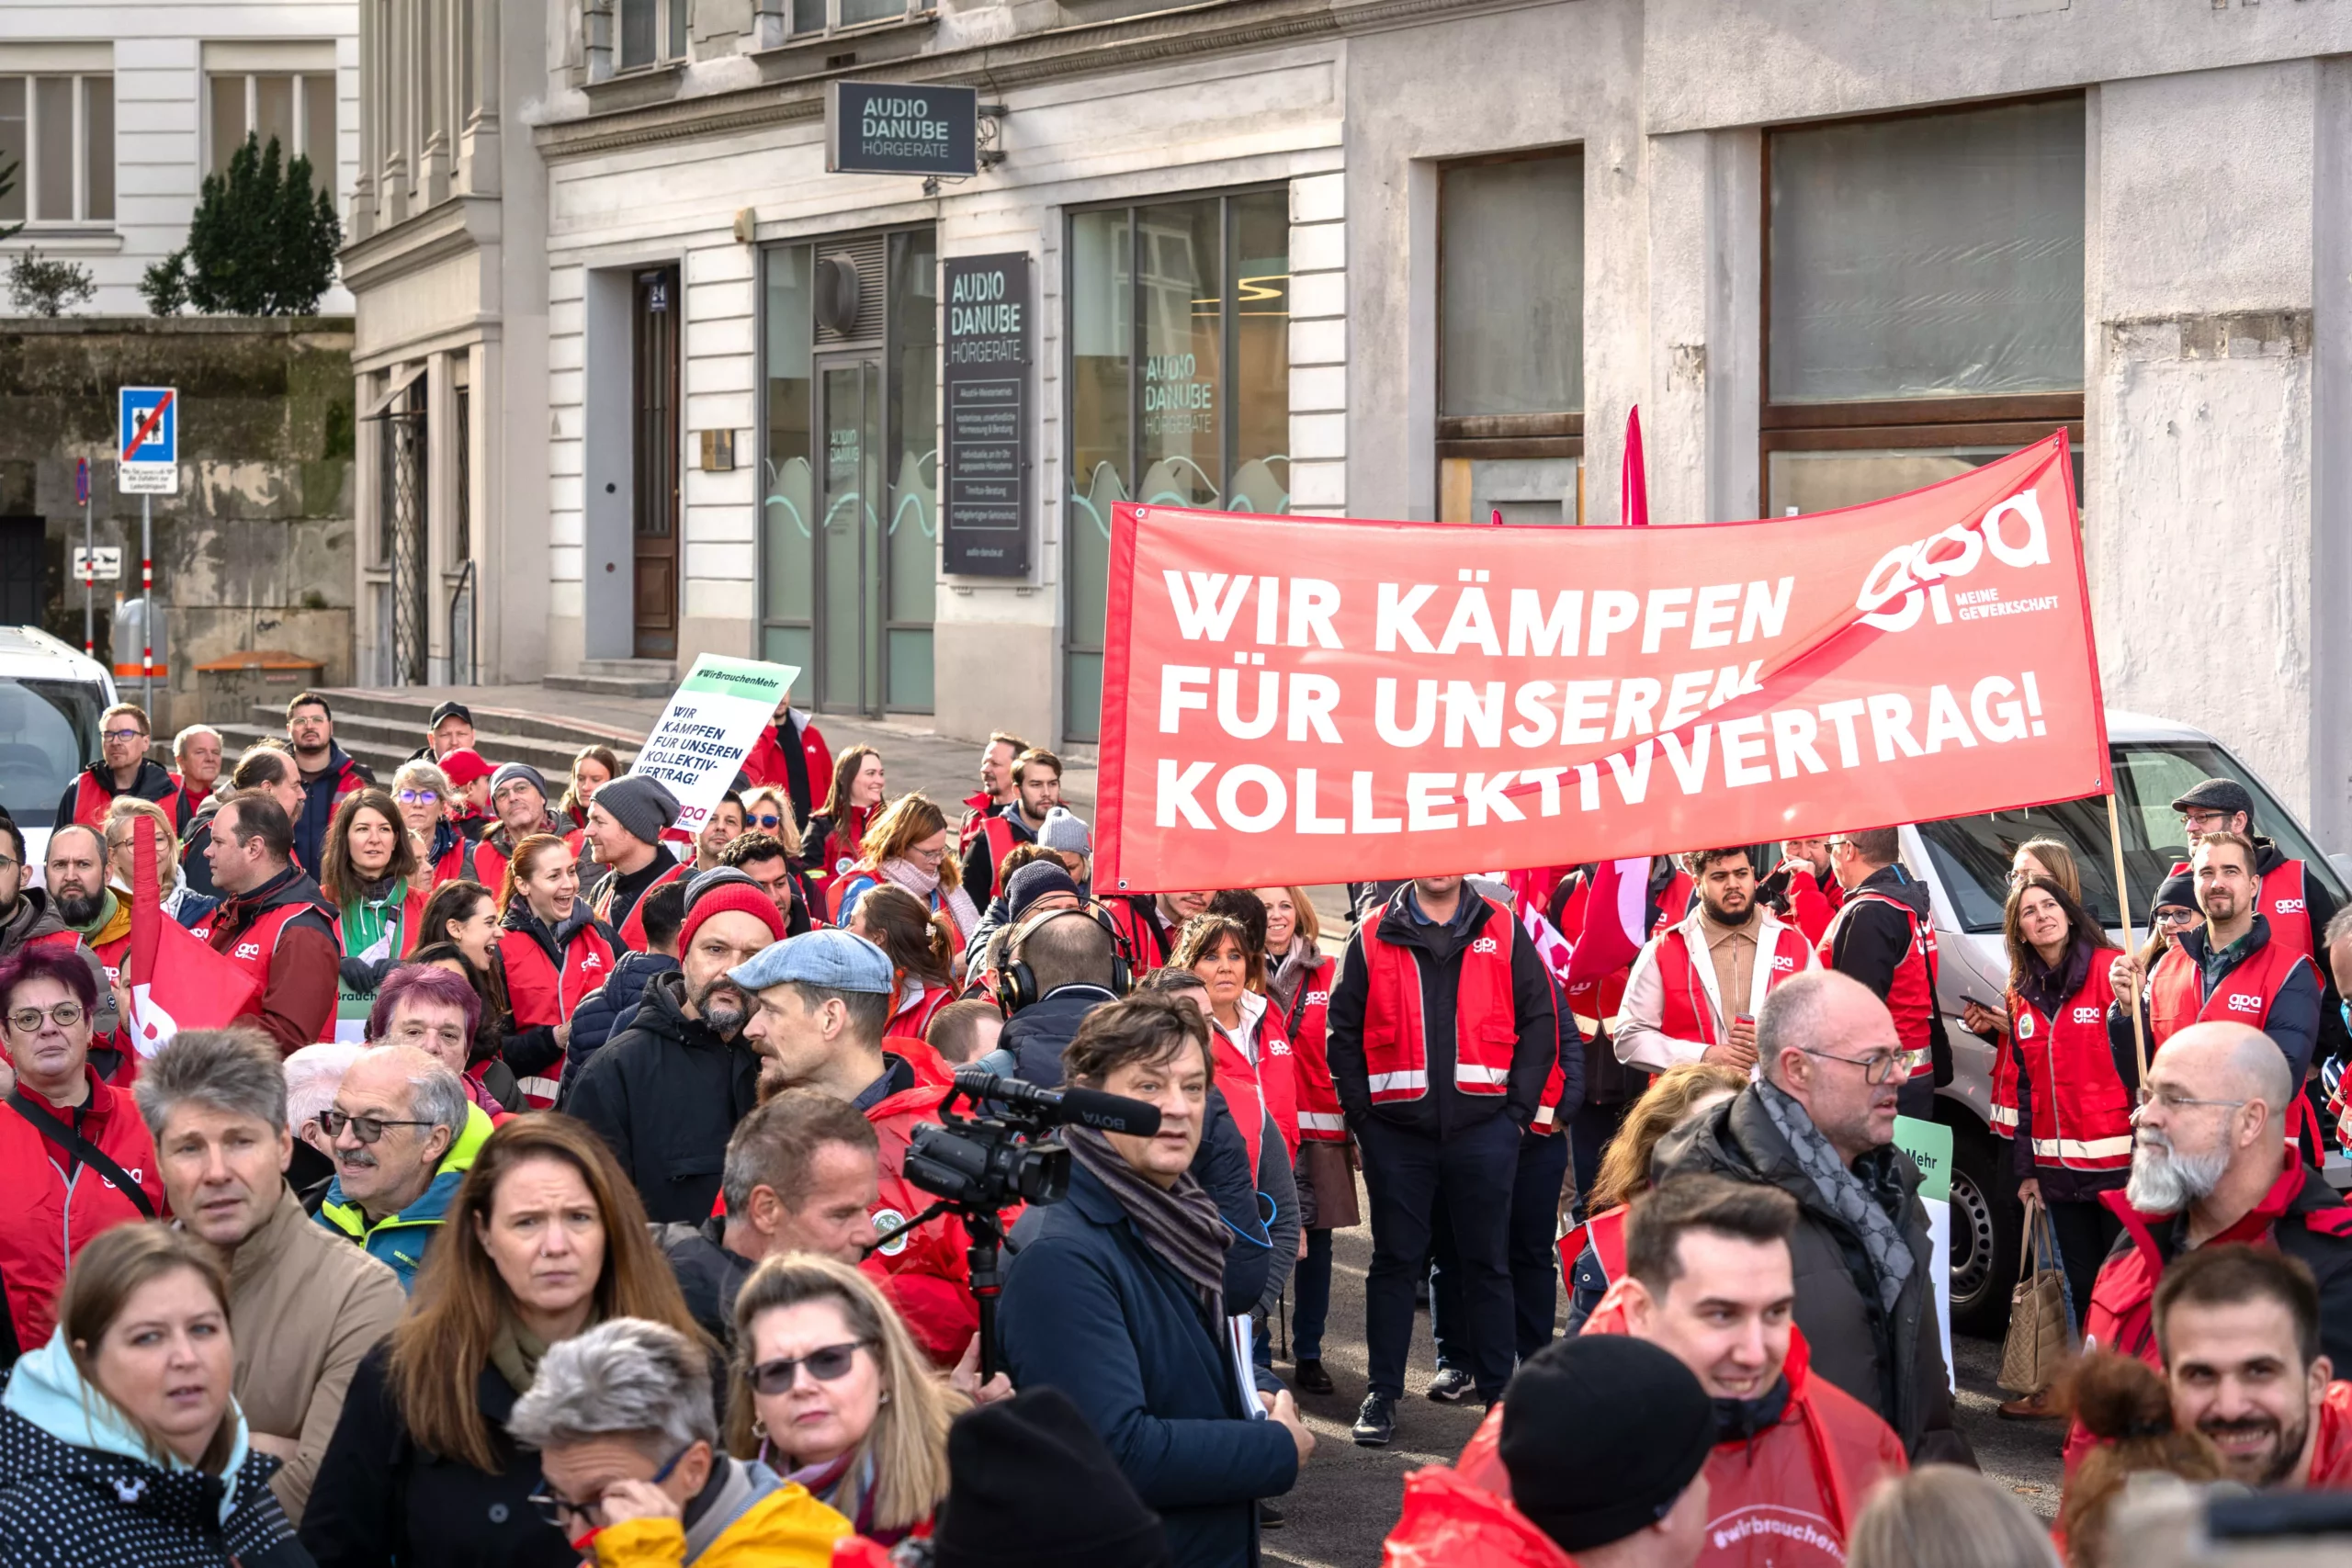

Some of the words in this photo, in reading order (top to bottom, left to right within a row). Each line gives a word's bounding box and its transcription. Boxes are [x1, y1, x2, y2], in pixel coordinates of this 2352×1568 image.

[863, 97, 928, 118] AUDIO
[863, 118, 949, 140] DANUBE
[863, 140, 949, 158] HÖRGERÄTE
[952, 271, 1004, 303] AUDIO
[952, 303, 1021, 335] DANUBE
[952, 336, 1021, 364] HÖRGERÄTE
[1146, 353, 1195, 381] AUDIO
[1145, 383, 1212, 412] DANUBE
[1145, 412, 1212, 435] HÖRGERÄTE
[831, 446, 860, 462] DANUB
[1851, 489, 2052, 633] gpa
[1955, 588, 1998, 606] MEINE
[1959, 595, 2059, 621] GEWERKSCHAFT
[1163, 570, 1344, 649] WIR
[1375, 569, 1794, 657] KÄMPFEN
[696, 669, 779, 689] #WirBrauchenMehr
[1159, 651, 1343, 744] FÜR
[1374, 660, 1764, 749] UNSEREN
[673, 705, 696, 718] WIR
[662, 719, 726, 740] KÄMPFEN
[653, 734, 678, 749] FÜR
[680, 739, 743, 761] UNSEREN
[1155, 671, 2048, 835] KOLLEKTIVVERTRAG!
[644, 750, 718, 772] KOLLEKTIV-
[639, 765, 699, 785] VERTRAG!
[2275, 898, 2303, 915] gpa
[1773, 955, 1793, 970] pa
[2228, 993, 2262, 1010] gpa
[2073, 1007, 2099, 1024] gpa
[1081, 1111, 1125, 1132] BOYA
